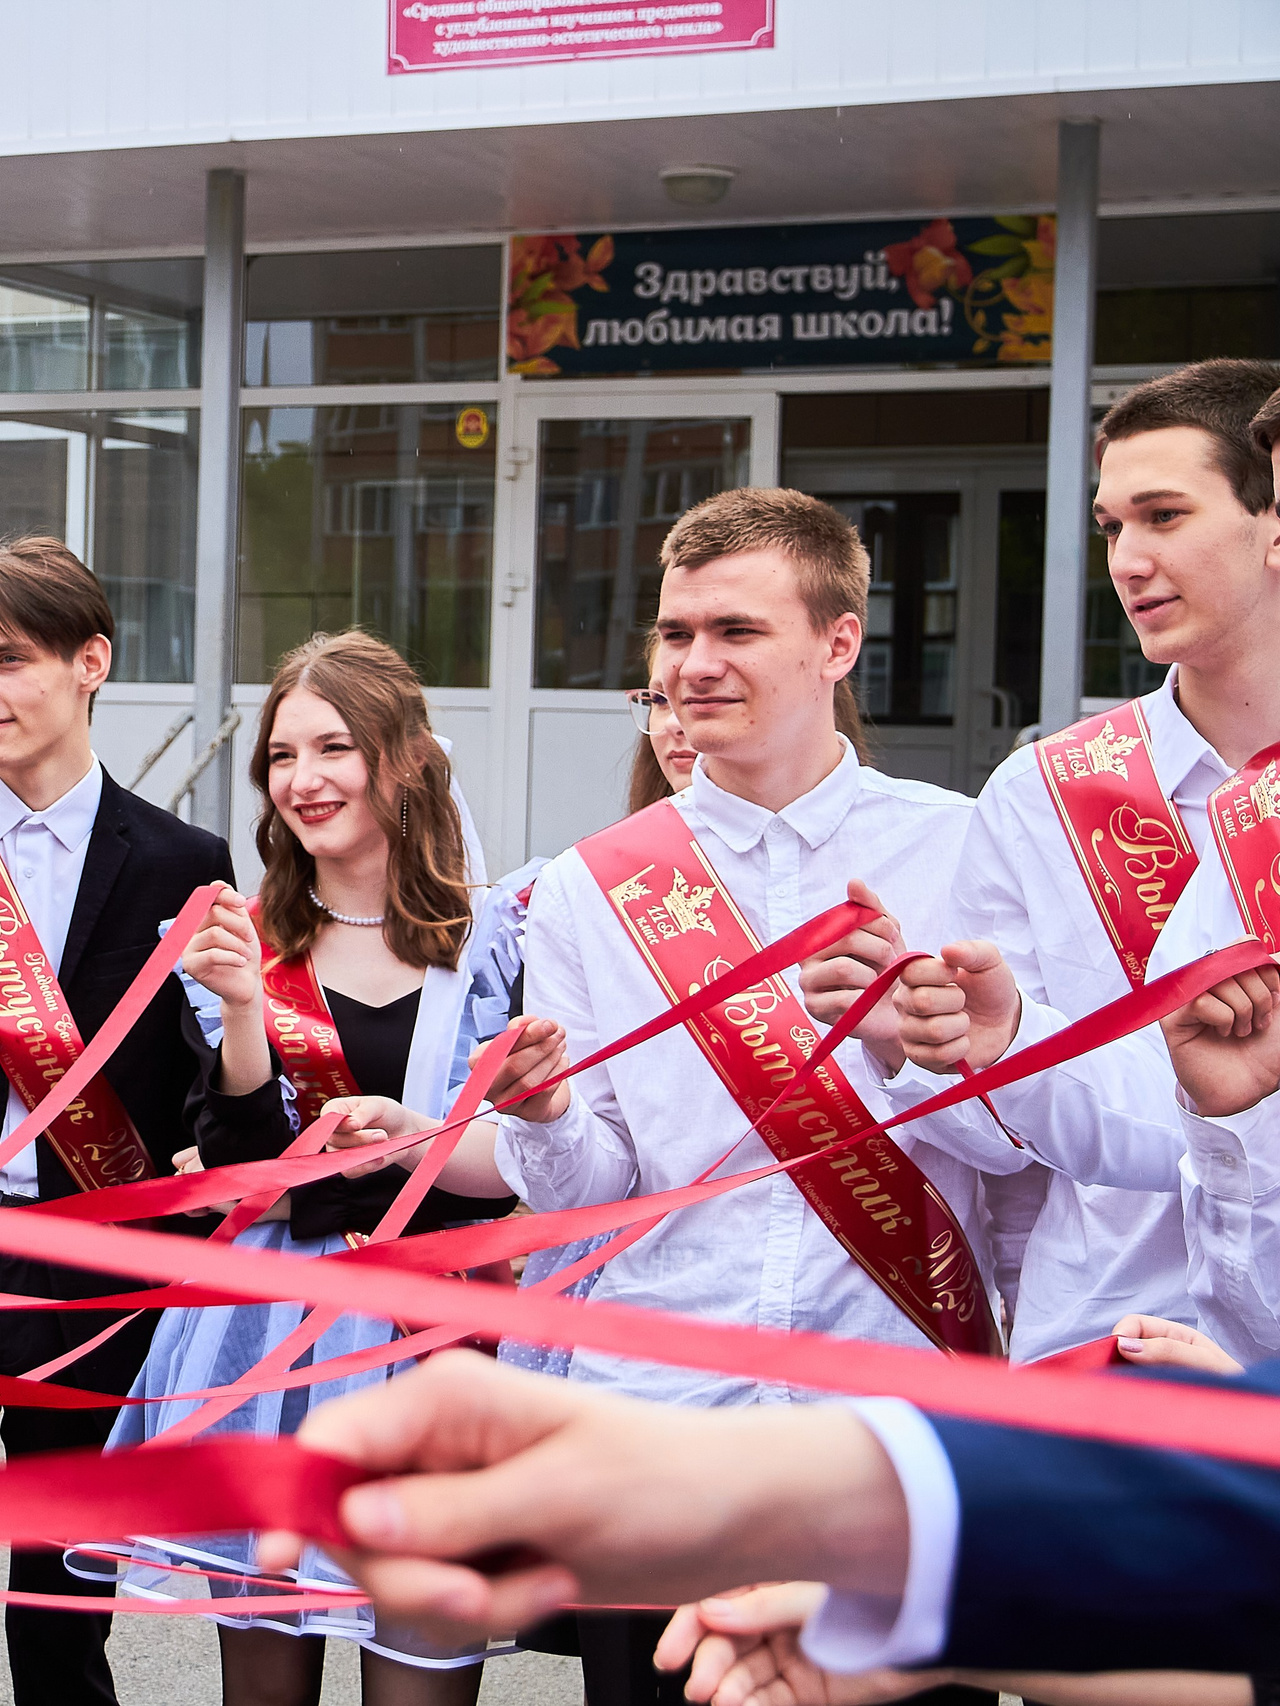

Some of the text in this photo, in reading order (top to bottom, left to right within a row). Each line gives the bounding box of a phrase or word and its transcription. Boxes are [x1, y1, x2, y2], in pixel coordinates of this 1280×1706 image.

[634, 250, 900, 302] Здравствуй,
[583, 298, 953, 347] любимая школа!
[23, 952, 60, 1013] Голдобин
[13, 1072, 37, 1110] Новосибир
[789, 1025, 901, 1175] Выегжанин Егор
[760, 1124, 783, 1146] СОШ
[802, 1180, 841, 1231] Новосибирск
[902, 1229, 978, 1323] 2025
